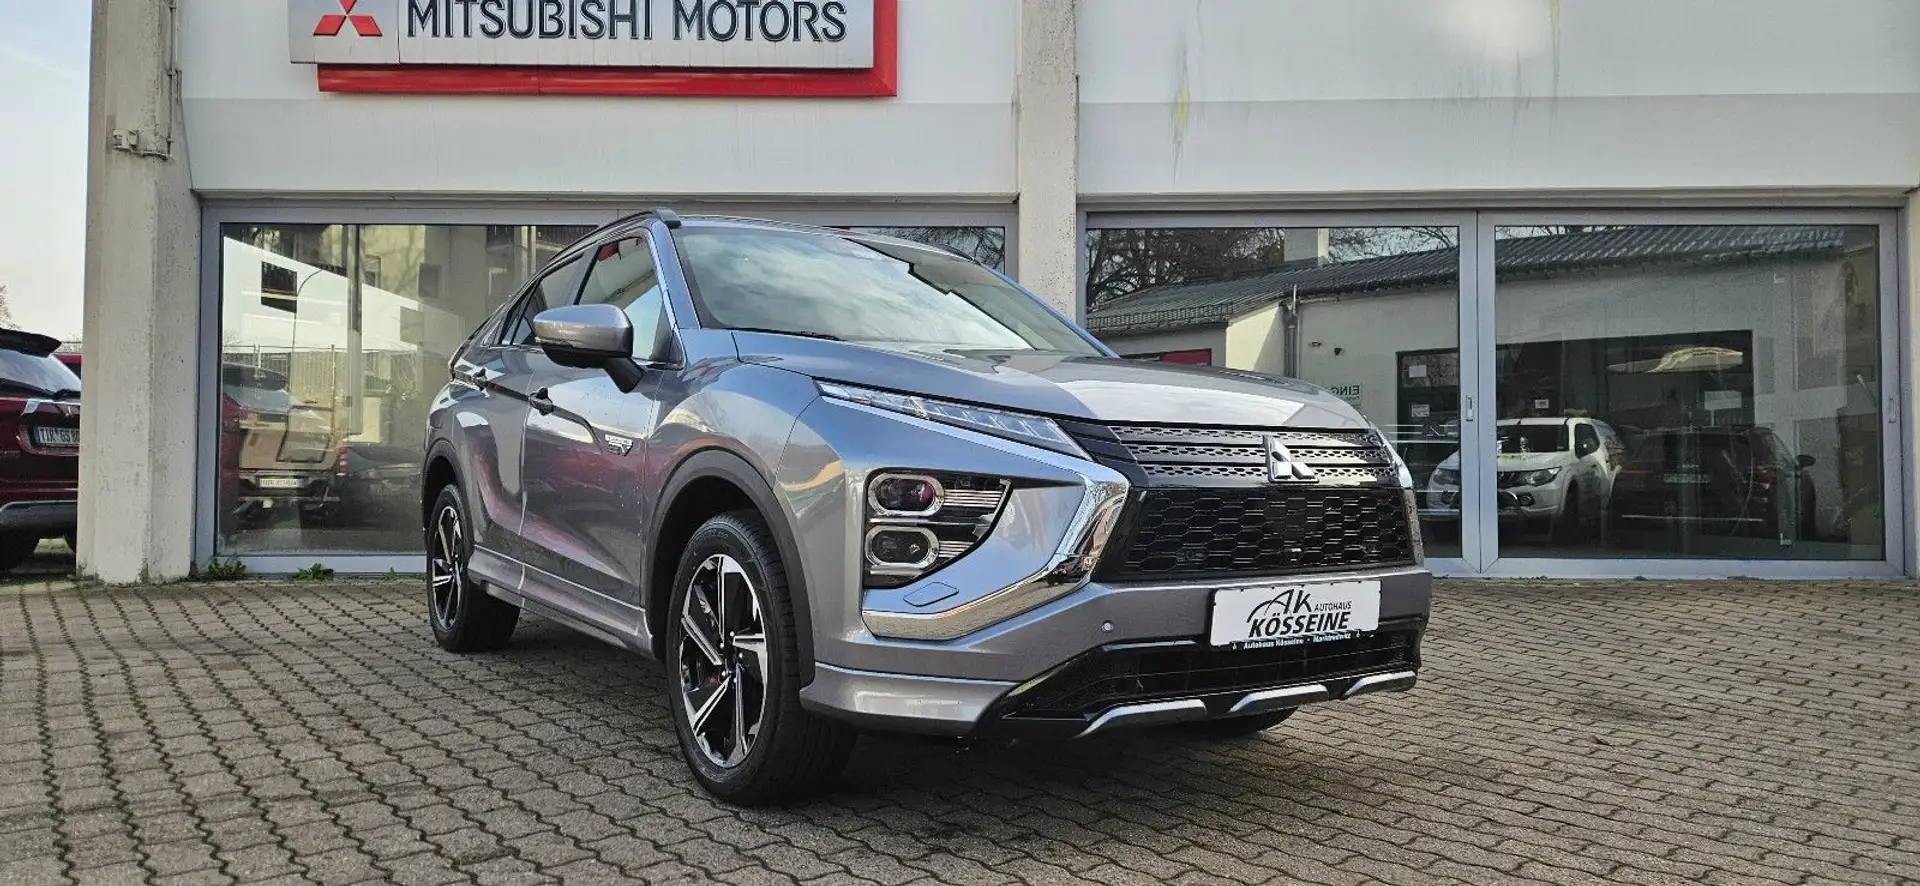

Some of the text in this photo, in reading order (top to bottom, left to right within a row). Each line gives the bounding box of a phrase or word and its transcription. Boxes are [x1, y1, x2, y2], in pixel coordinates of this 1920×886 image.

[407, 0, 847, 41] MITSUBISHI MOTORS
[1314, 601, 1352, 612] AUTOHAUS
[1248, 611, 1351, 637] KÖSSEINE
[1243, 640, 1274, 649] Autohaus
